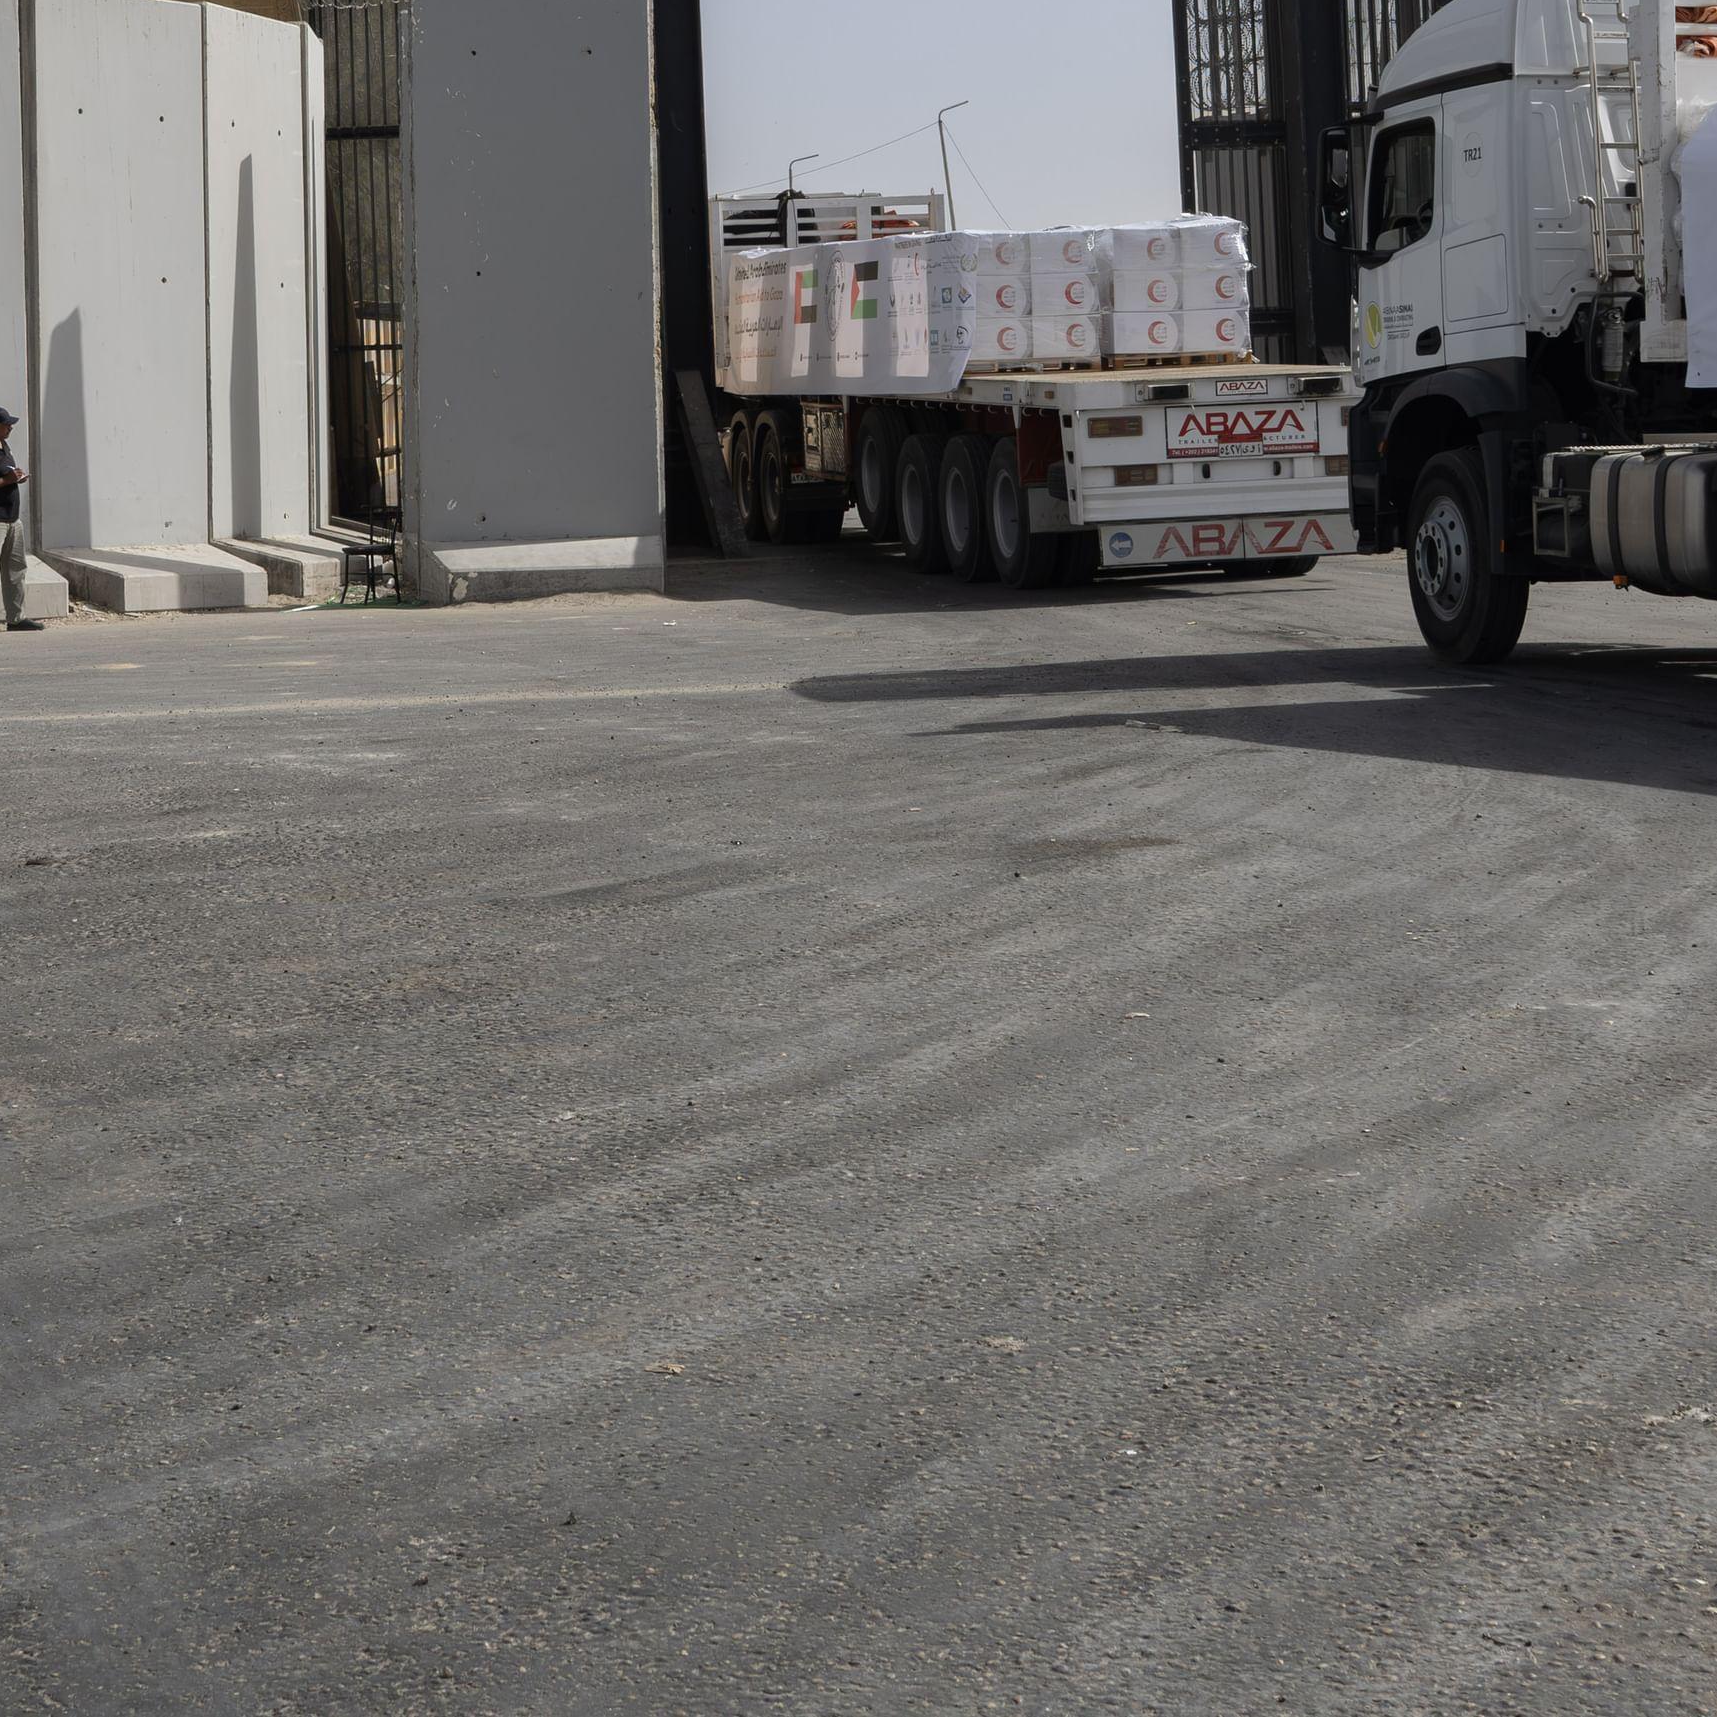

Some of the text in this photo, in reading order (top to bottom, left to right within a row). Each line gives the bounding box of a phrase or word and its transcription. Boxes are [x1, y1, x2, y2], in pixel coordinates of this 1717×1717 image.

[1463, 146, 1482, 163] TR21
[1219, 380, 1265, 392] ABAZA
[1178, 409, 1305, 437] ABAZA
[1152, 518, 1335, 559] ABAZA
